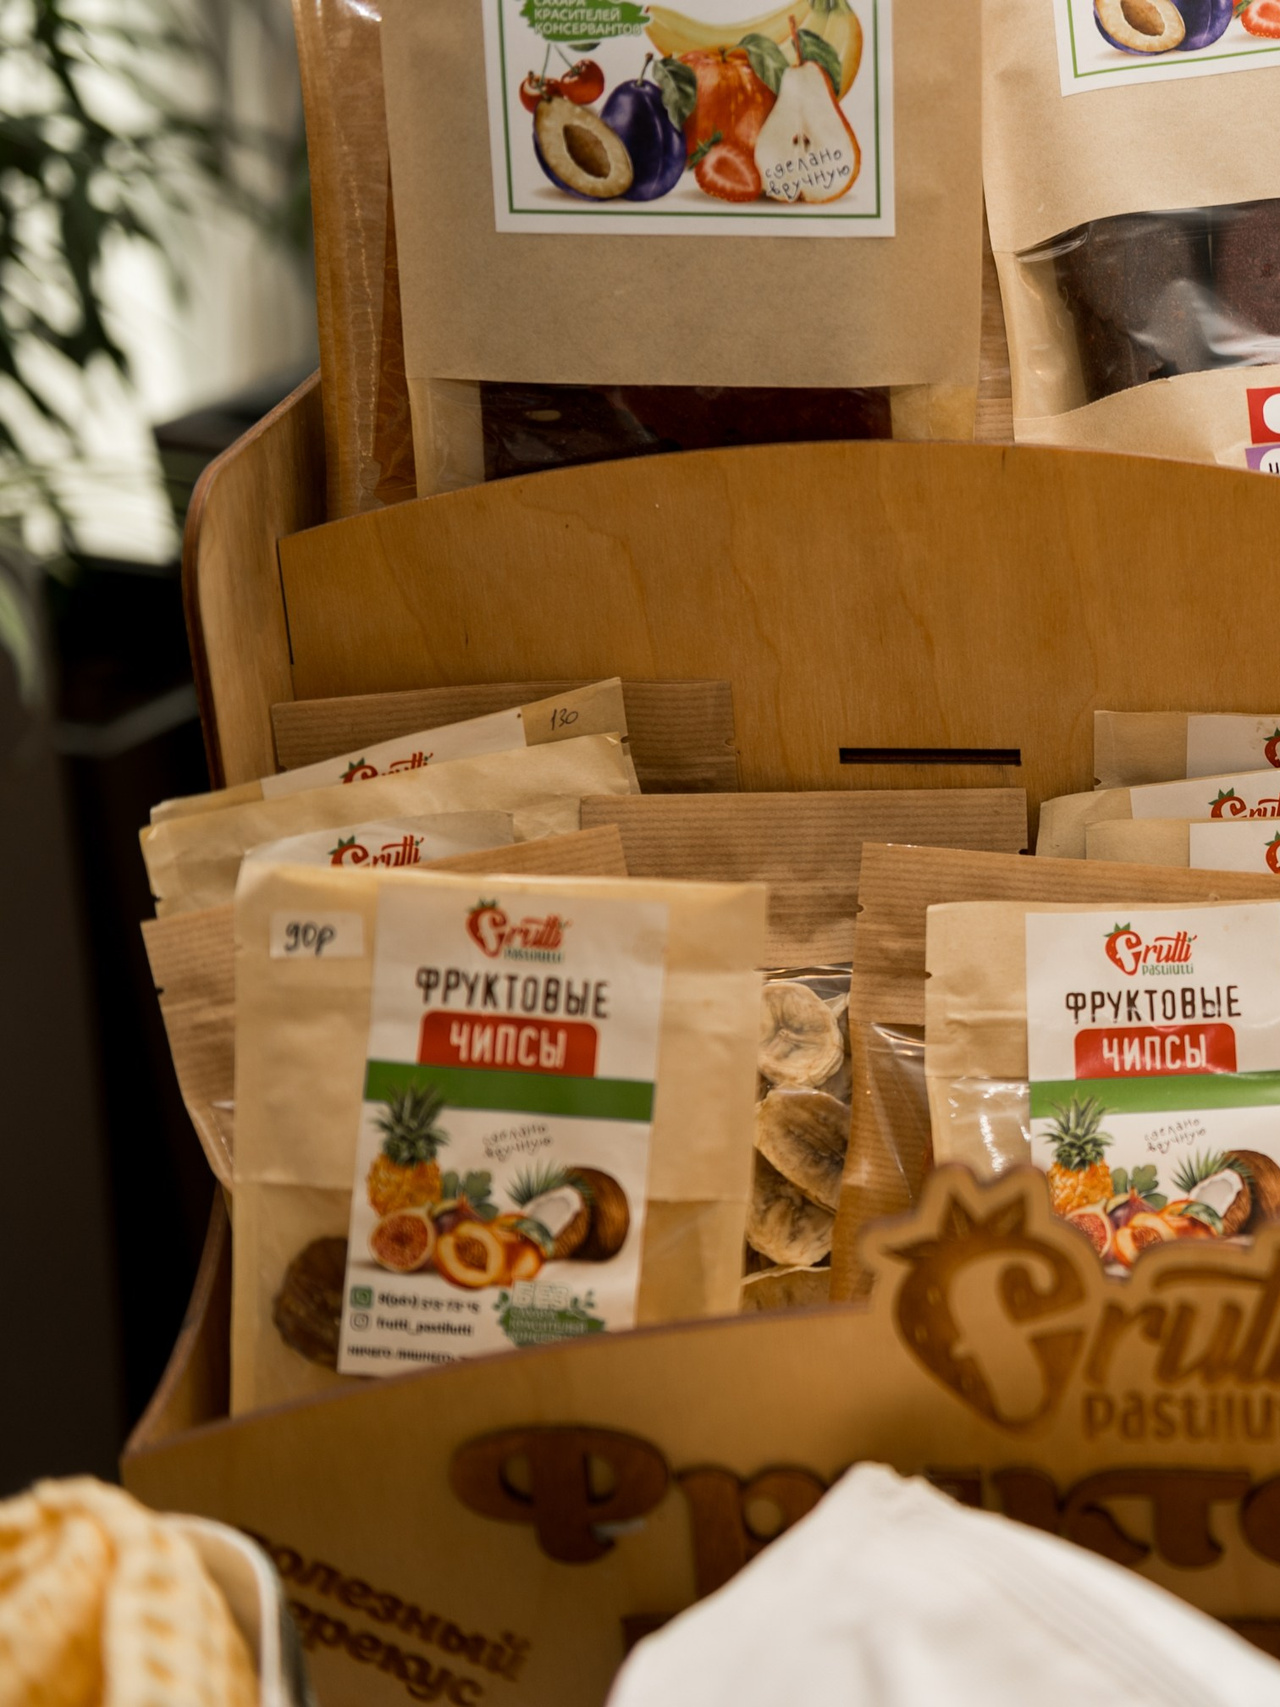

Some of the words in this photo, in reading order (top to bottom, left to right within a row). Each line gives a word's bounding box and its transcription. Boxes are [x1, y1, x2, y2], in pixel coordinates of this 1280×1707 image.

[534, 7, 621, 22] КРАСИТЕЛЕЙ
[534, 23, 642, 36] КОНСЕРВАНТОВ
[765, 148, 842, 179] сделано
[769, 165, 850, 200] вручную
[551, 708, 578, 731] 130
[1105, 929, 1197, 976] Frutti
[416, 967, 610, 1019] ФРУКТОВЫЕ
[1065, 985, 1242, 1024] ФРУКТОВЫЕ
[450, 1020, 567, 1069] ЧИПСЫ
[1102, 1033, 1207, 1072] ЧИПСЫ
[250, 1528, 531, 1682] олезный
